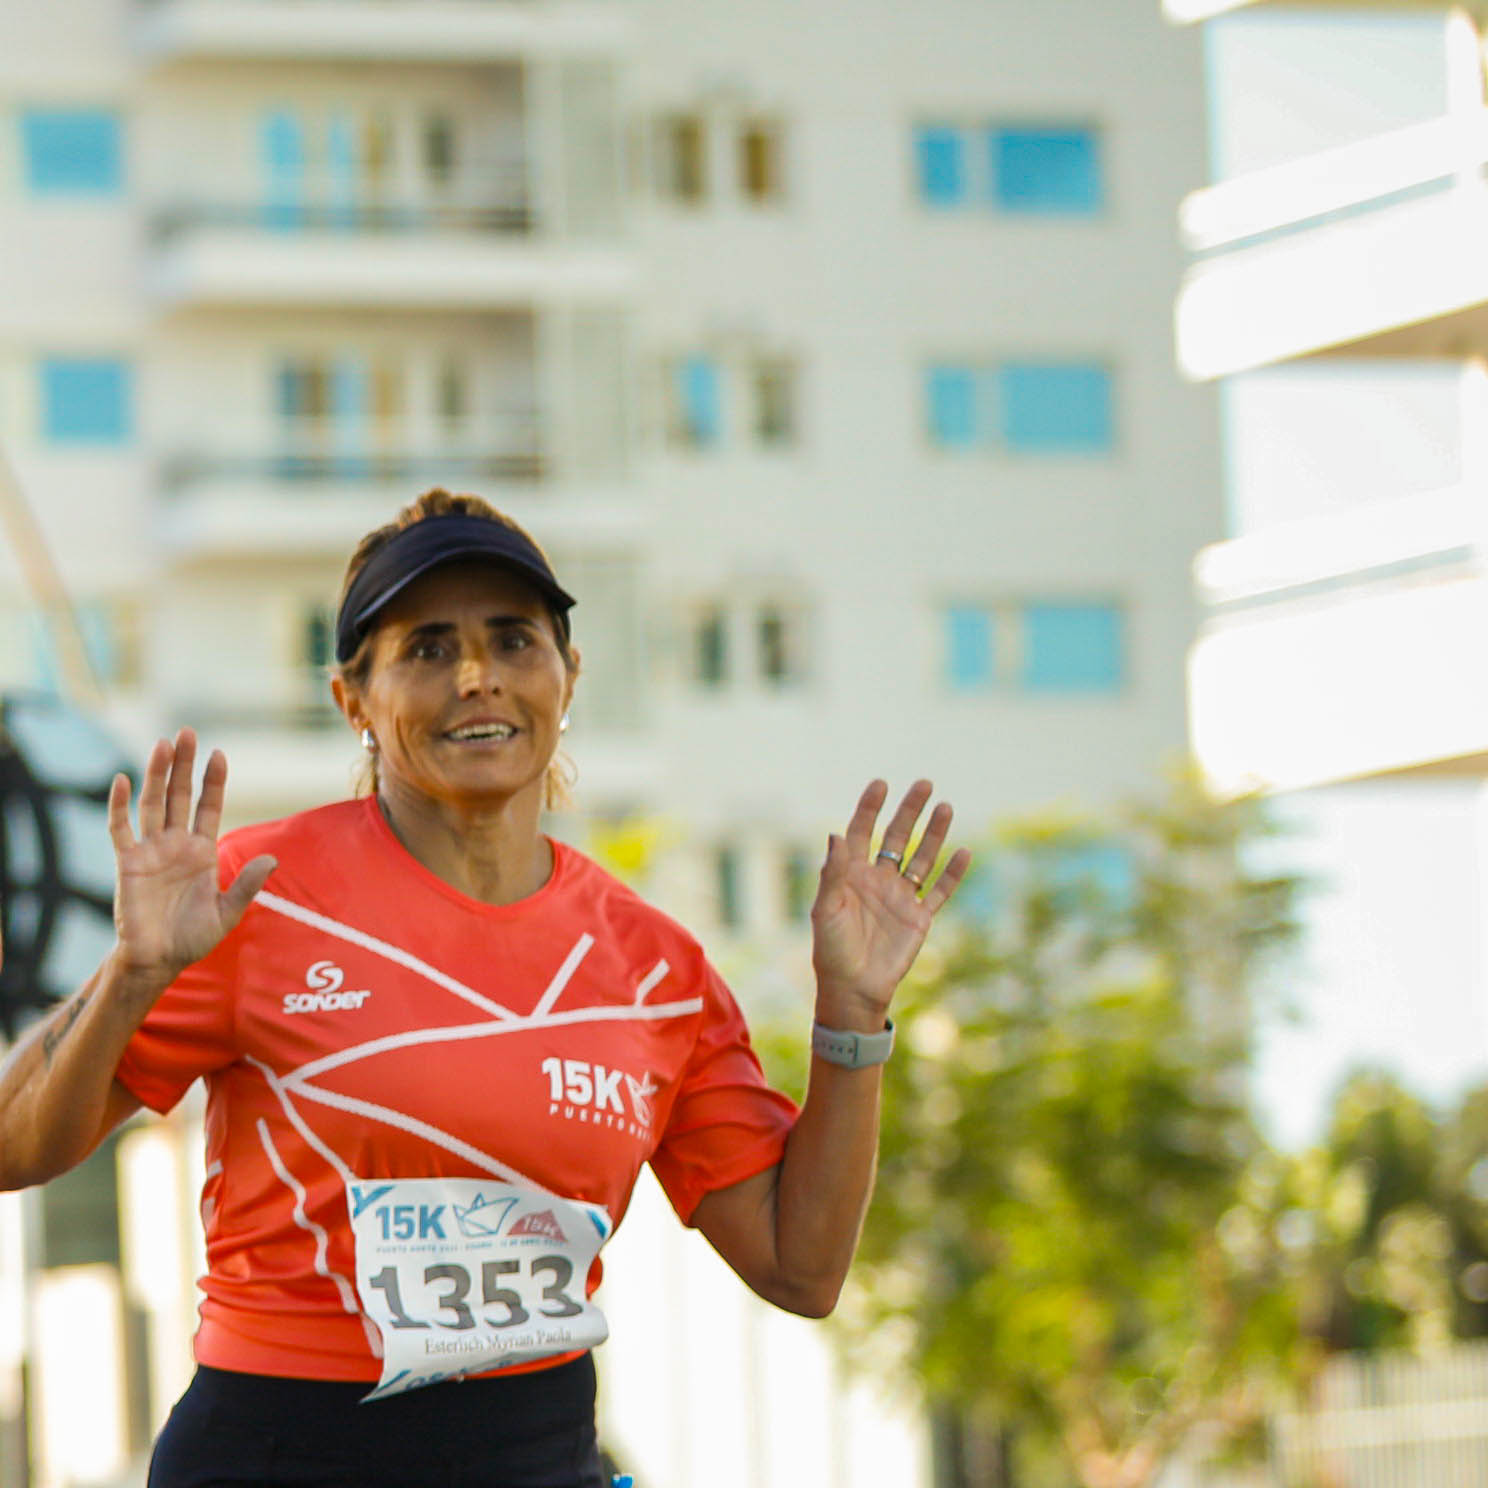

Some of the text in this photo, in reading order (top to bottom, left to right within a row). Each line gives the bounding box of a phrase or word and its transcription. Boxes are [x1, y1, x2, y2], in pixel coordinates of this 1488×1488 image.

[541, 1056, 625, 1115] 15K
[375, 1204, 447, 1240] 15K
[369, 1255, 583, 1331] 1353
